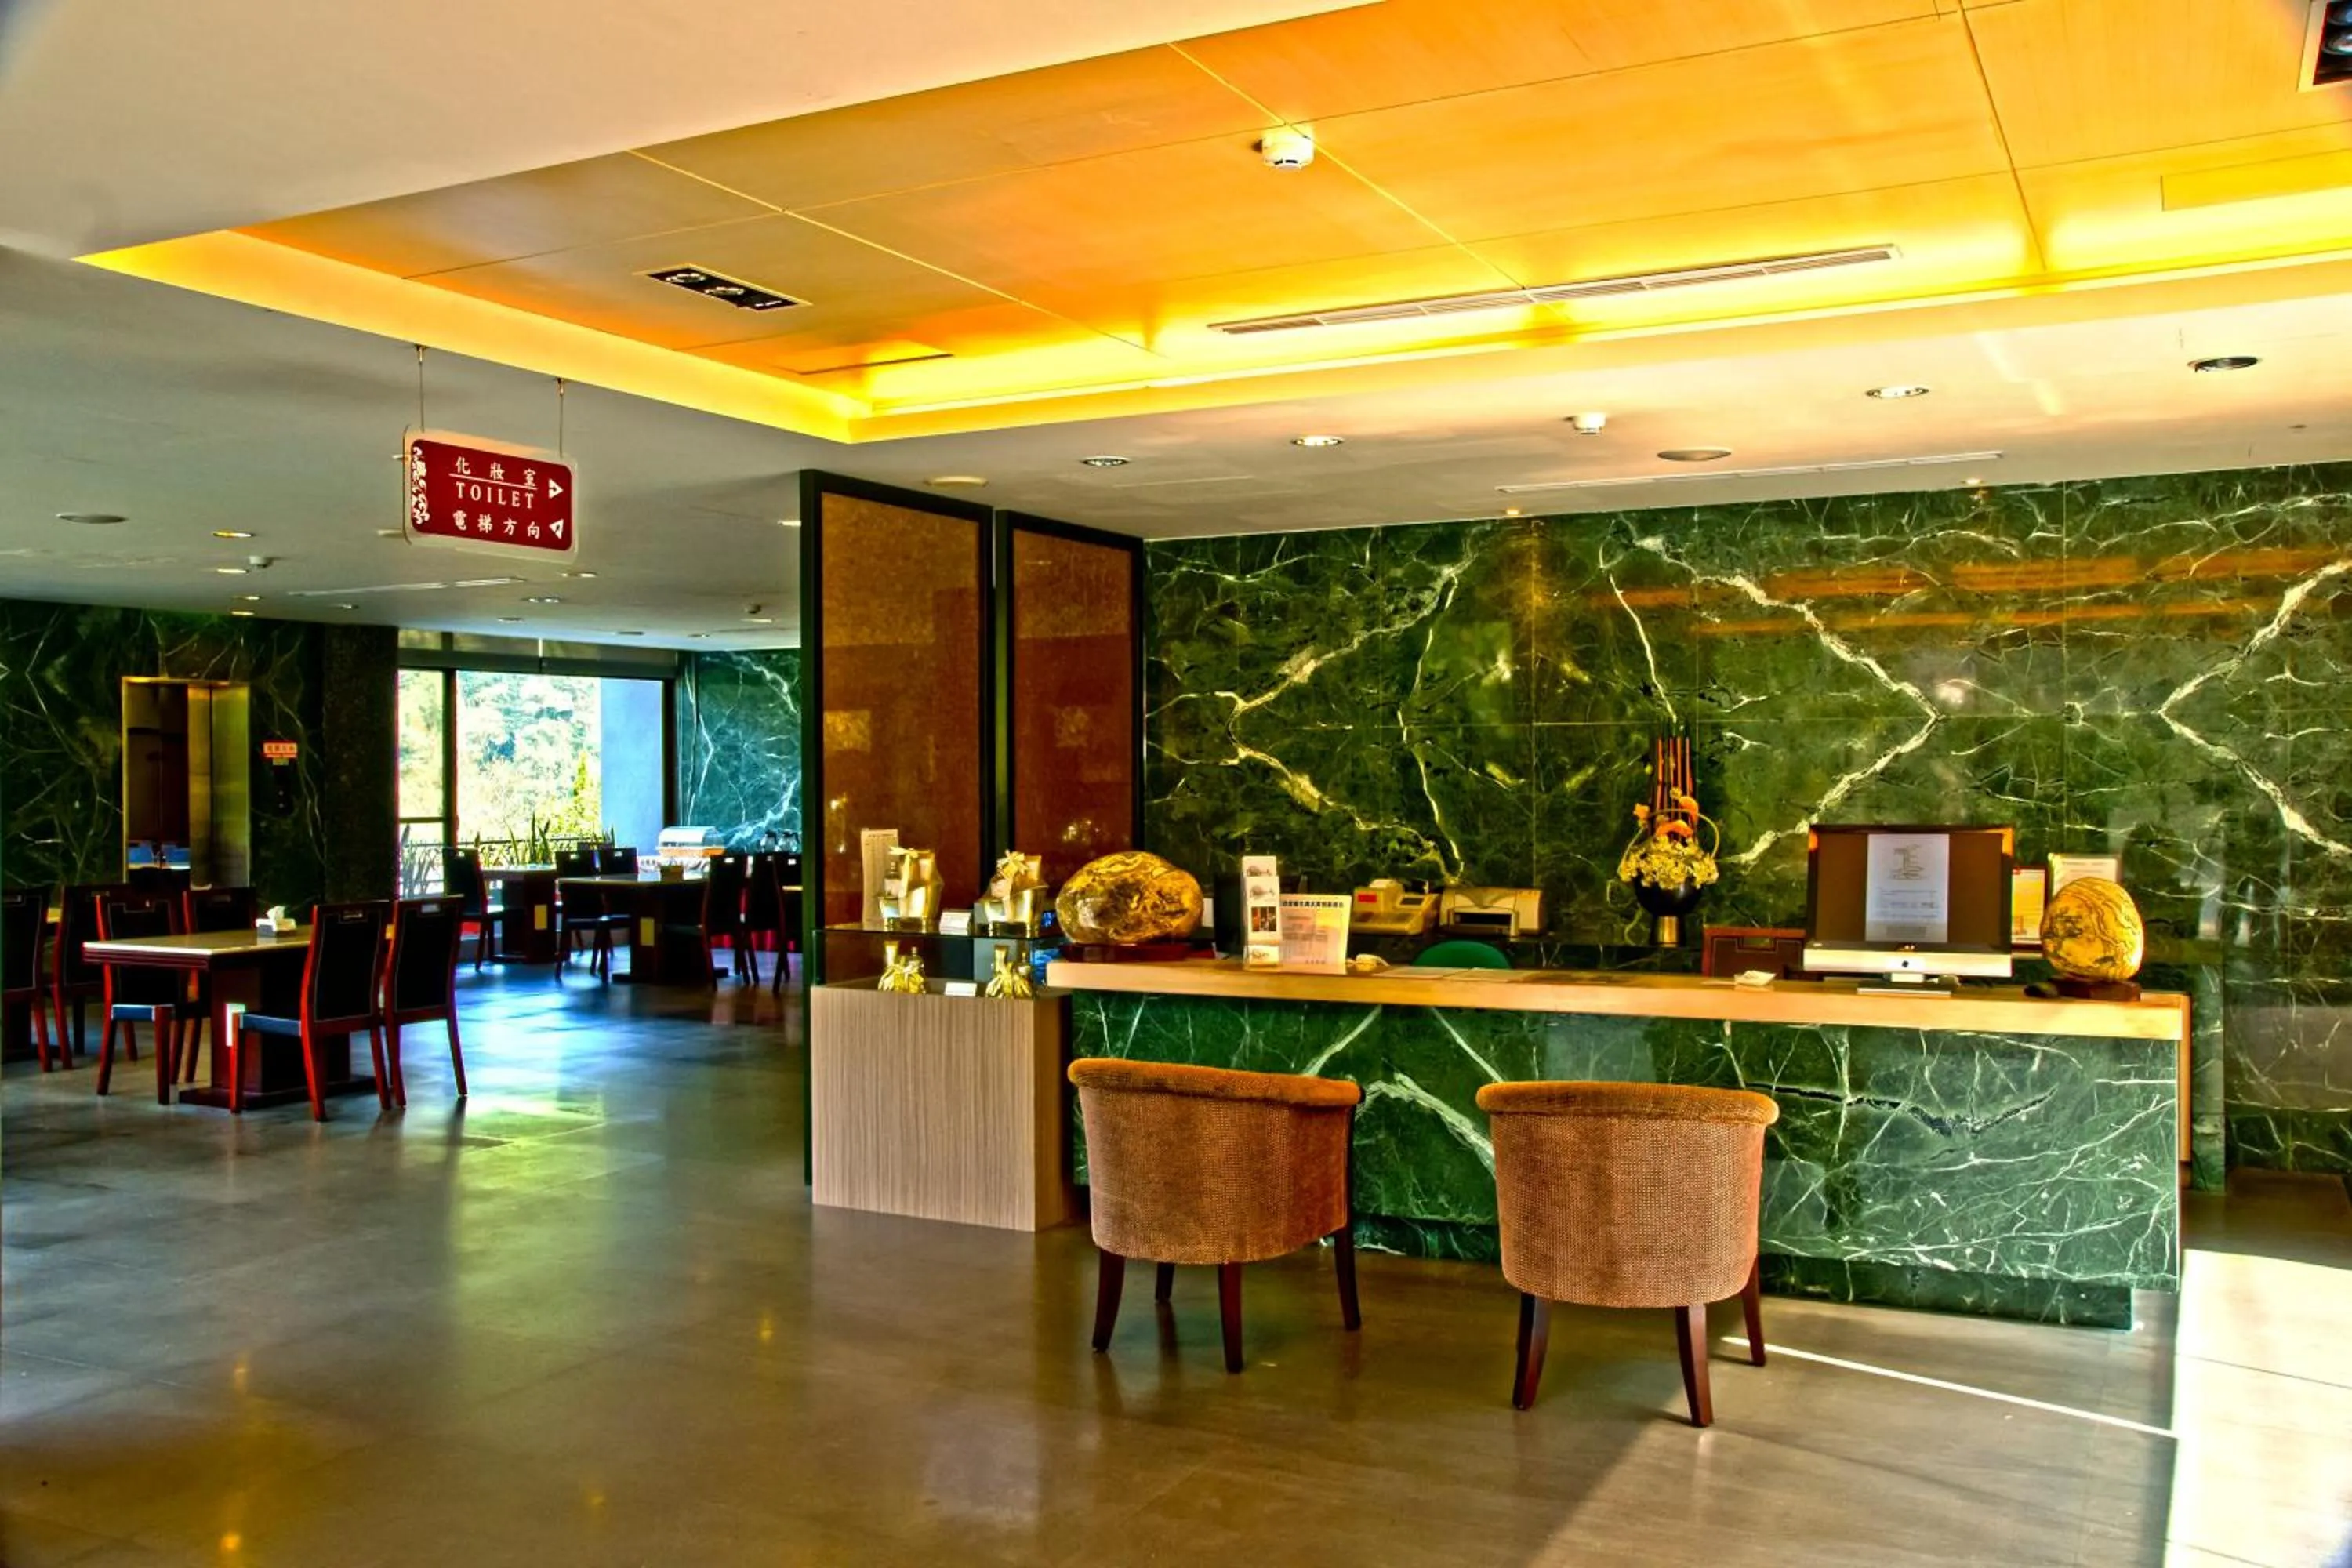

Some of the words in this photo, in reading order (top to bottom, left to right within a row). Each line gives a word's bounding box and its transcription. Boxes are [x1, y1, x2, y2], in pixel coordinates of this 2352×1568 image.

[456, 481, 534, 509] TOILET
[452, 510, 541, 540] 電梯方向
